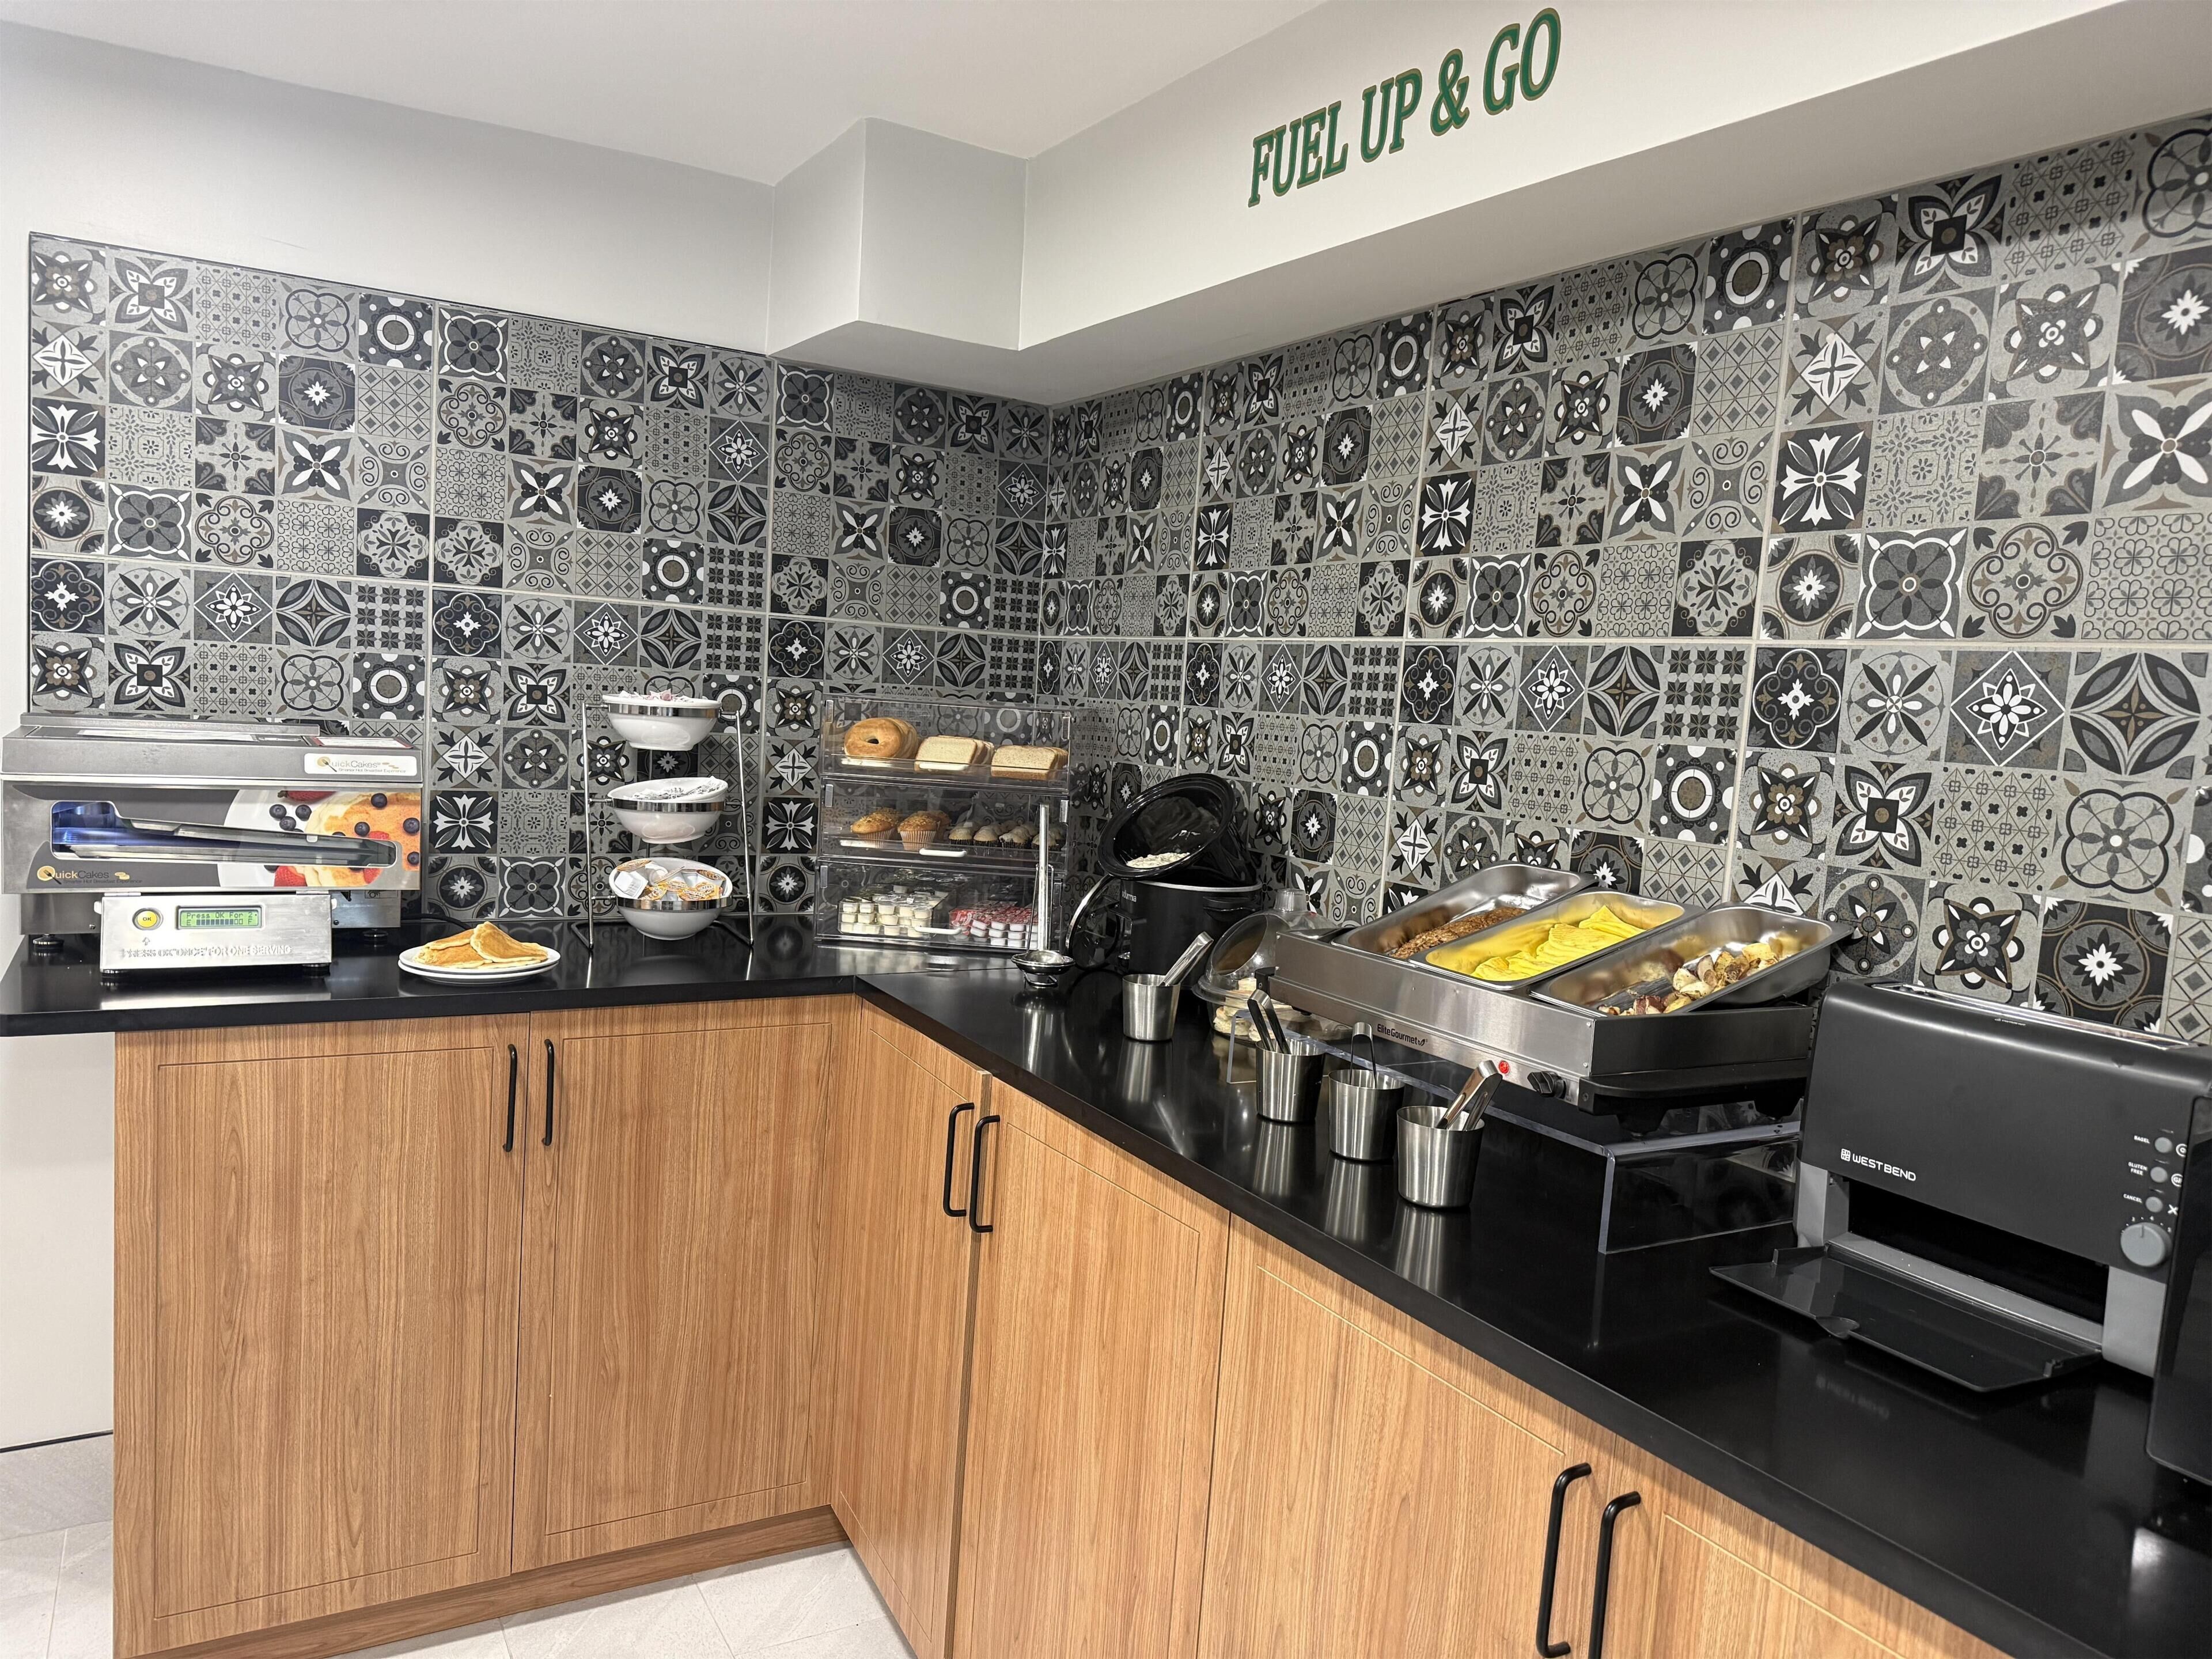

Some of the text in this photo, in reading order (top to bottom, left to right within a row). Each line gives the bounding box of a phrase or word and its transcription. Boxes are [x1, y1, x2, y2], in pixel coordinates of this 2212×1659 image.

[1248, 7, 1561, 208] FUEL UP & GO
[252, 945, 292, 955] SERVING
[2134, 1135, 2150, 1144] BAGEL
[2128, 1161, 2148, 1172] GLUTEN
[2130, 1168, 2143, 1176] FREE
[2123, 1194, 2142, 1203] CANCEL
